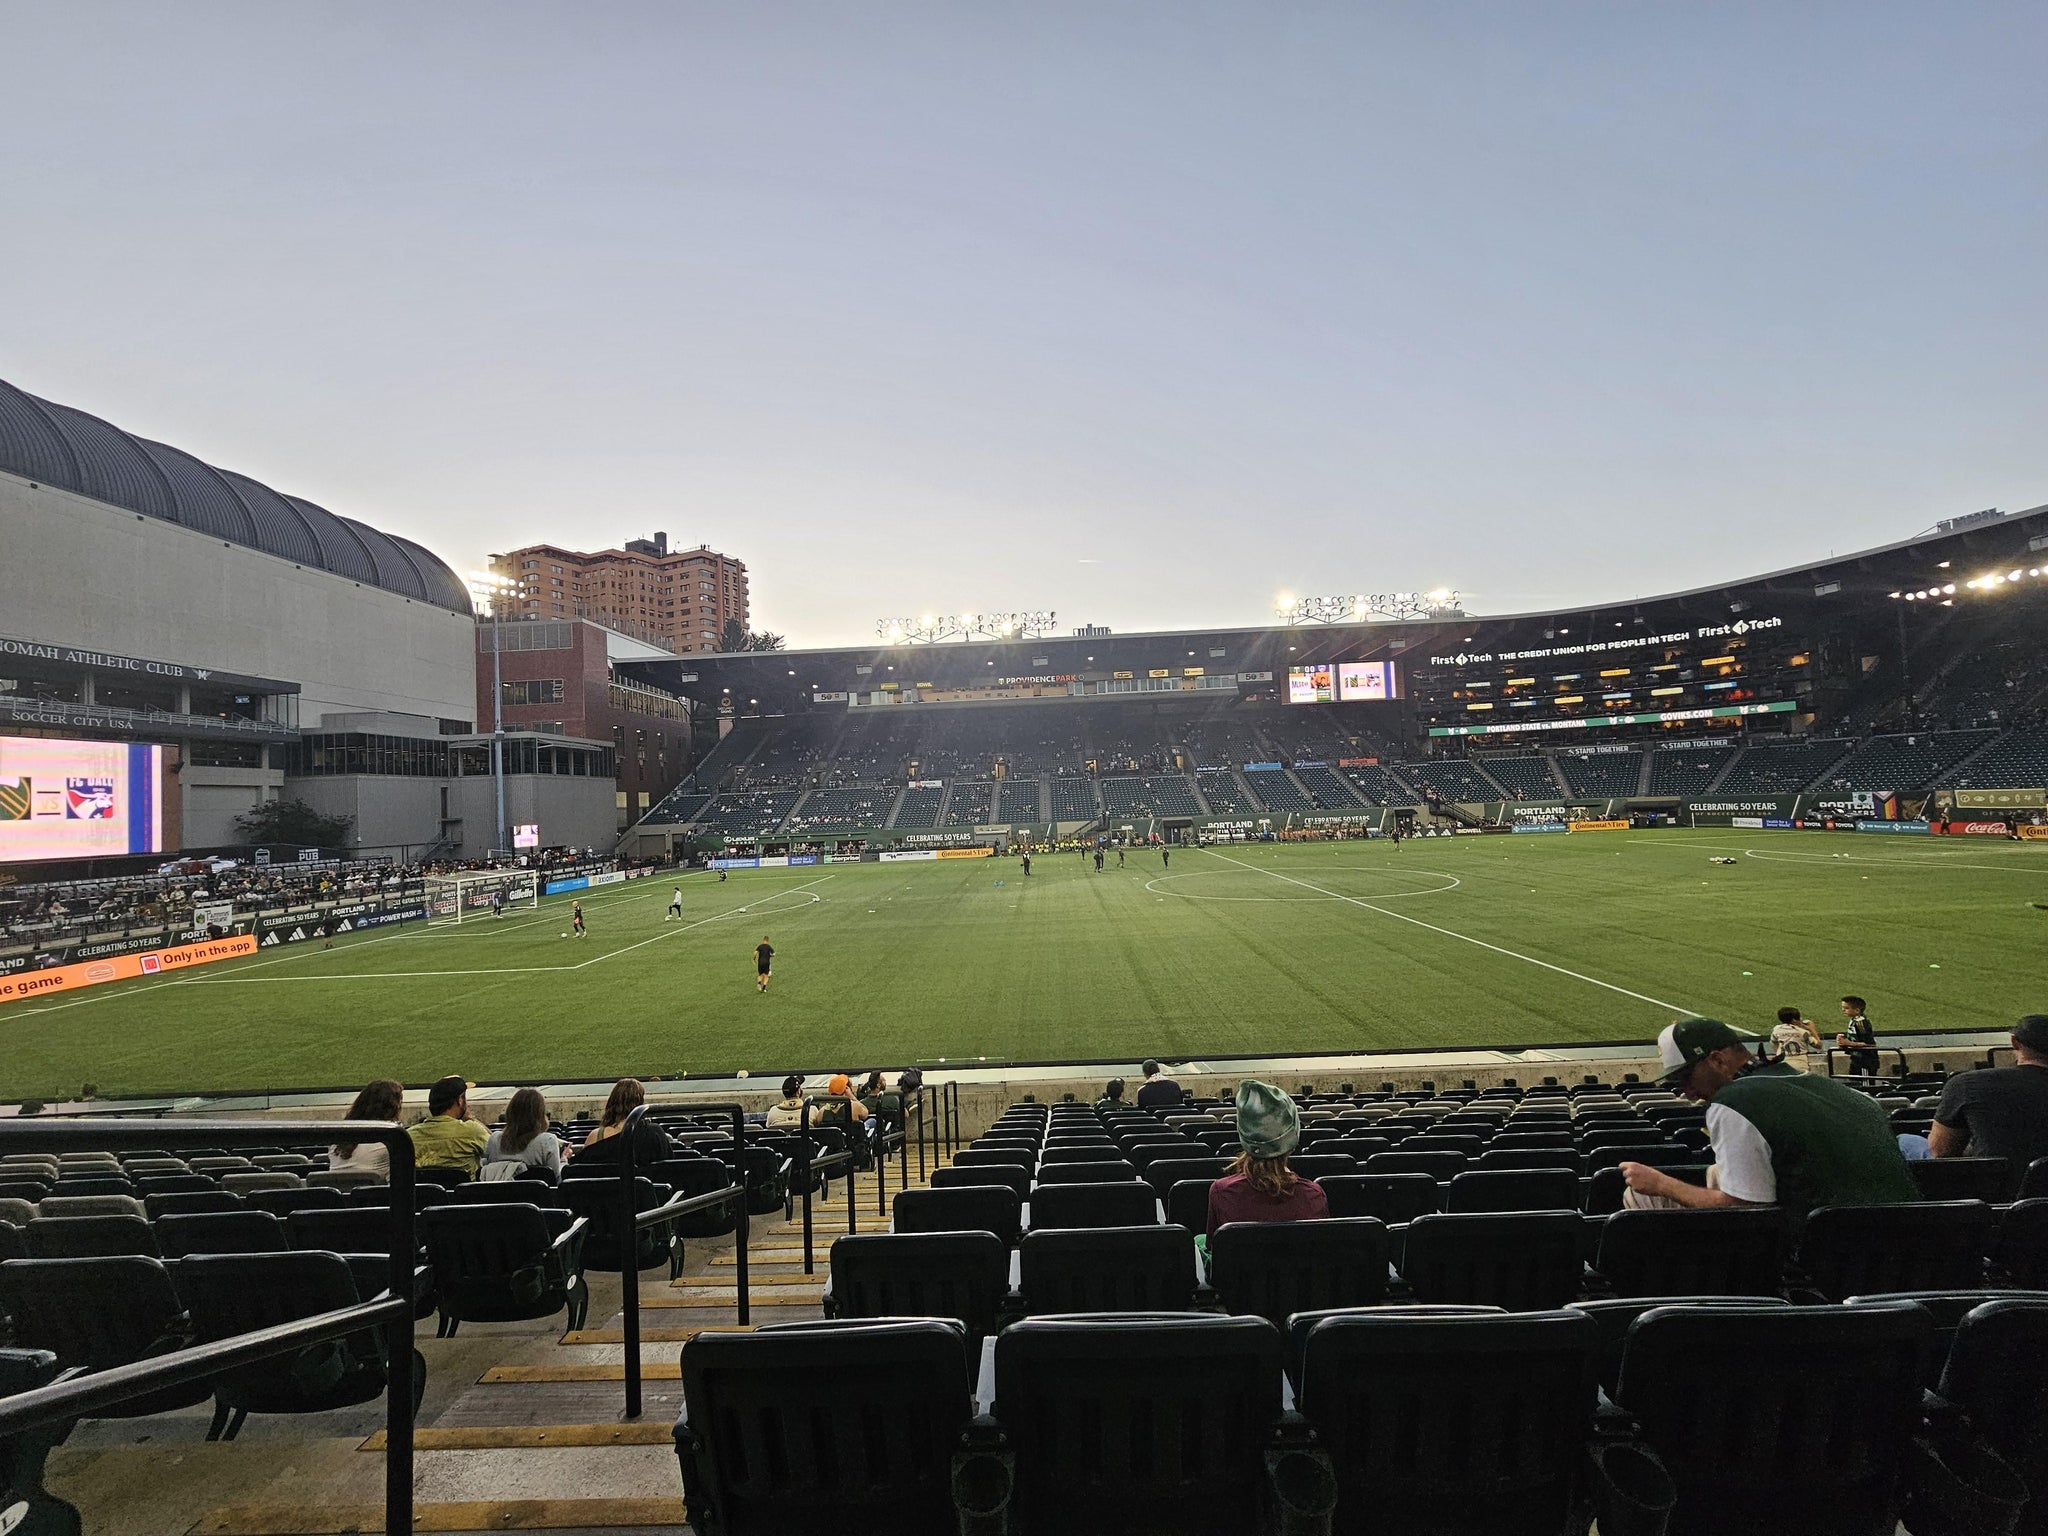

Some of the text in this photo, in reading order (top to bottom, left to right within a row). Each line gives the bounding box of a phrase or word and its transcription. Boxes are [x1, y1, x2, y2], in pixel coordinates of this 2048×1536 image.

[1698, 616, 1782, 638] First Tech
[1498, 632, 1690, 661] THE CREDIT UNION FOR PEOPLE IN TECH
[0, 640, 59, 659] OMAH
[65, 651, 140, 671] ATHLETIC
[146, 663, 183, 677] CLUB
[1431, 653, 1492, 665] First Tech
[12, 712, 133, 729] SOCCER CITY USA
[1660, 710, 1713, 721] GOVIKS.COM
[1486, 723, 1521, 733] PORTLAND
[1521, 721, 1541, 731] STATE
[1551, 719, 1587, 730] MONTANA
[1596, 745, 1629, 753] TOGETHER
[1668, 739, 1728, 749] STAND TOGETHER
[1514, 806, 1566, 816] PORTLAND
[1689, 803, 1739, 811] CELEBRATING
[1752, 802, 1777, 811] YEARS
[1351, 815, 1370, 823] YEARS
[1575, 821, 1607, 830] Continental
[907, 834, 944, 842] CELEBRATING
[298, 852, 319, 861] PUB
[598, 875, 615, 883] axiom
[510, 889, 534, 901] Gillette
[332, 905, 365, 916] PORTLAND
[263, 916, 296, 926] CELEBRATING
[304, 912, 320, 920] YEARS
[380, 913, 401, 923] POWER
[181, 926, 229, 940] PORTLD
[77, 936, 162, 957] CELEBRATING 50 YEARS
[163, 951, 195, 964] Only
[195, 949, 207, 958] in
[209, 943, 228, 955] the
[230, 941, 250, 954] app
[0, 974, 63, 995] e game
